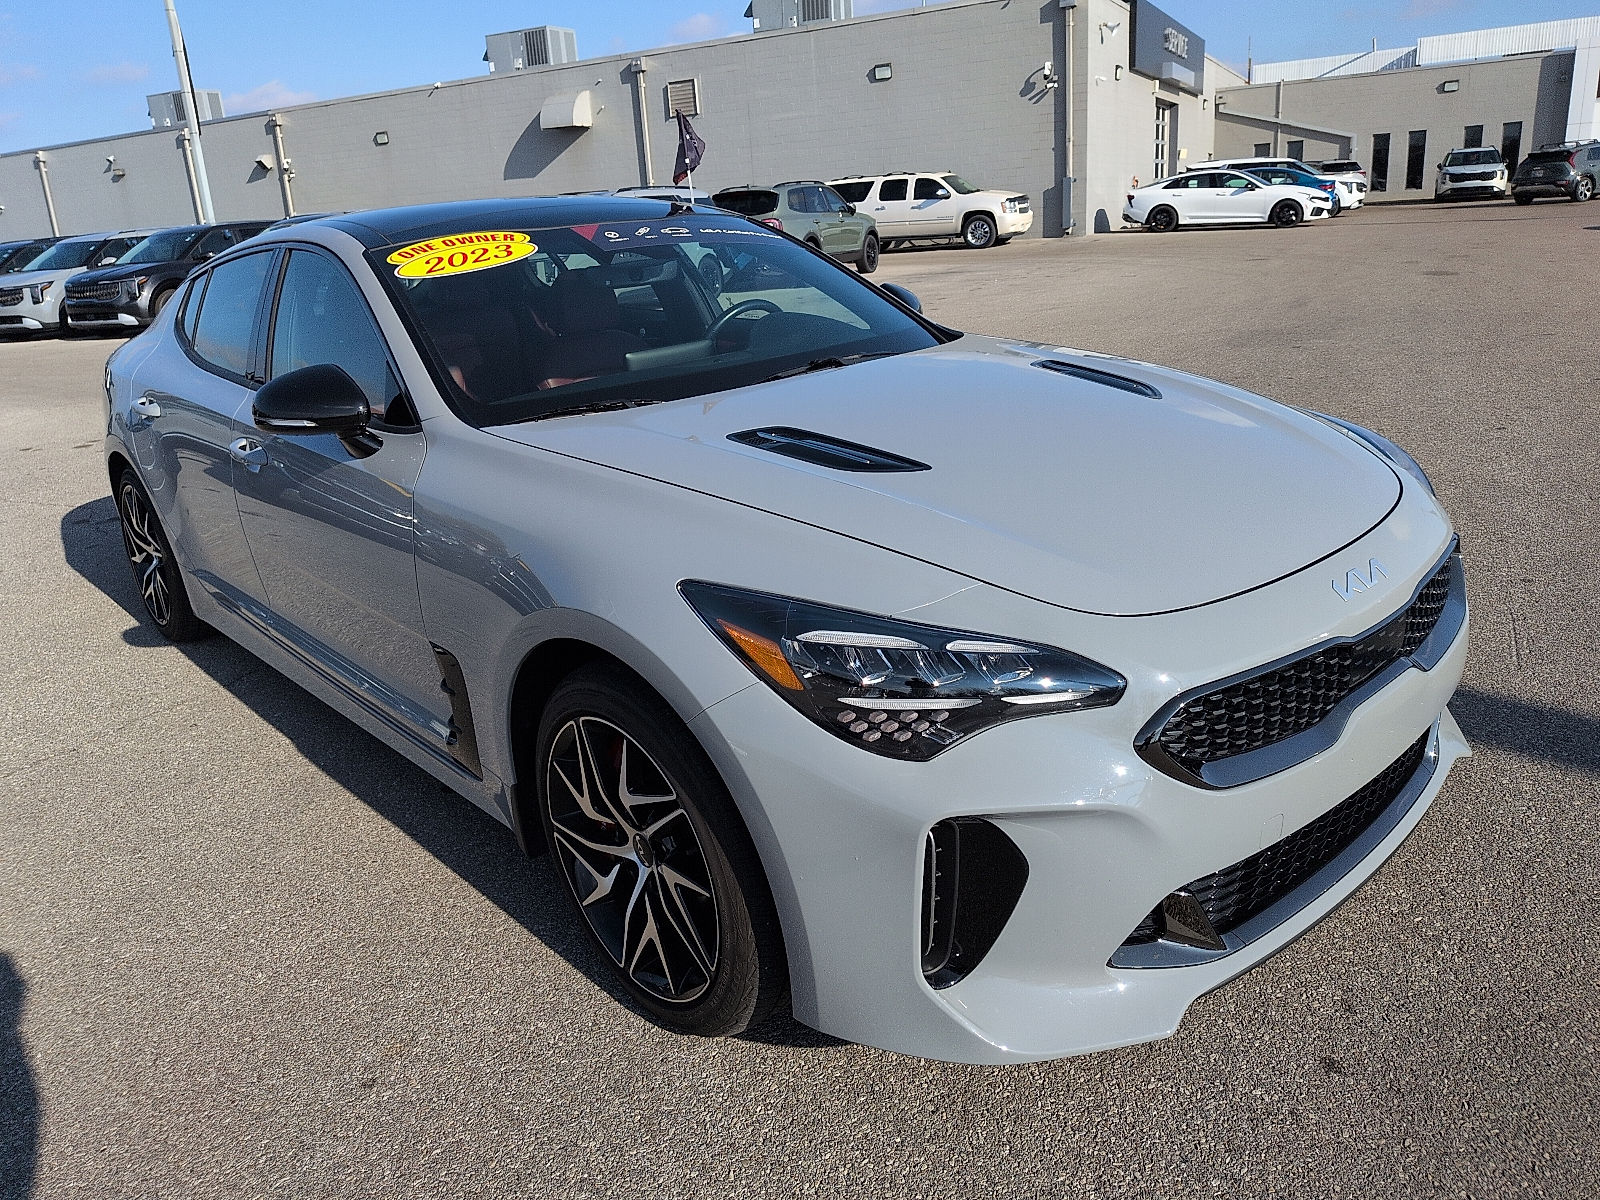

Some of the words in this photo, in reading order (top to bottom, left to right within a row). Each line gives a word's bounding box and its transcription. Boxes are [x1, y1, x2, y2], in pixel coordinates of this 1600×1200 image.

[397, 242, 439, 259] ONE
[441, 233, 515, 247] OWNER
[424, 244, 513, 274] 2023
[1331, 557, 1388, 602] KIA
